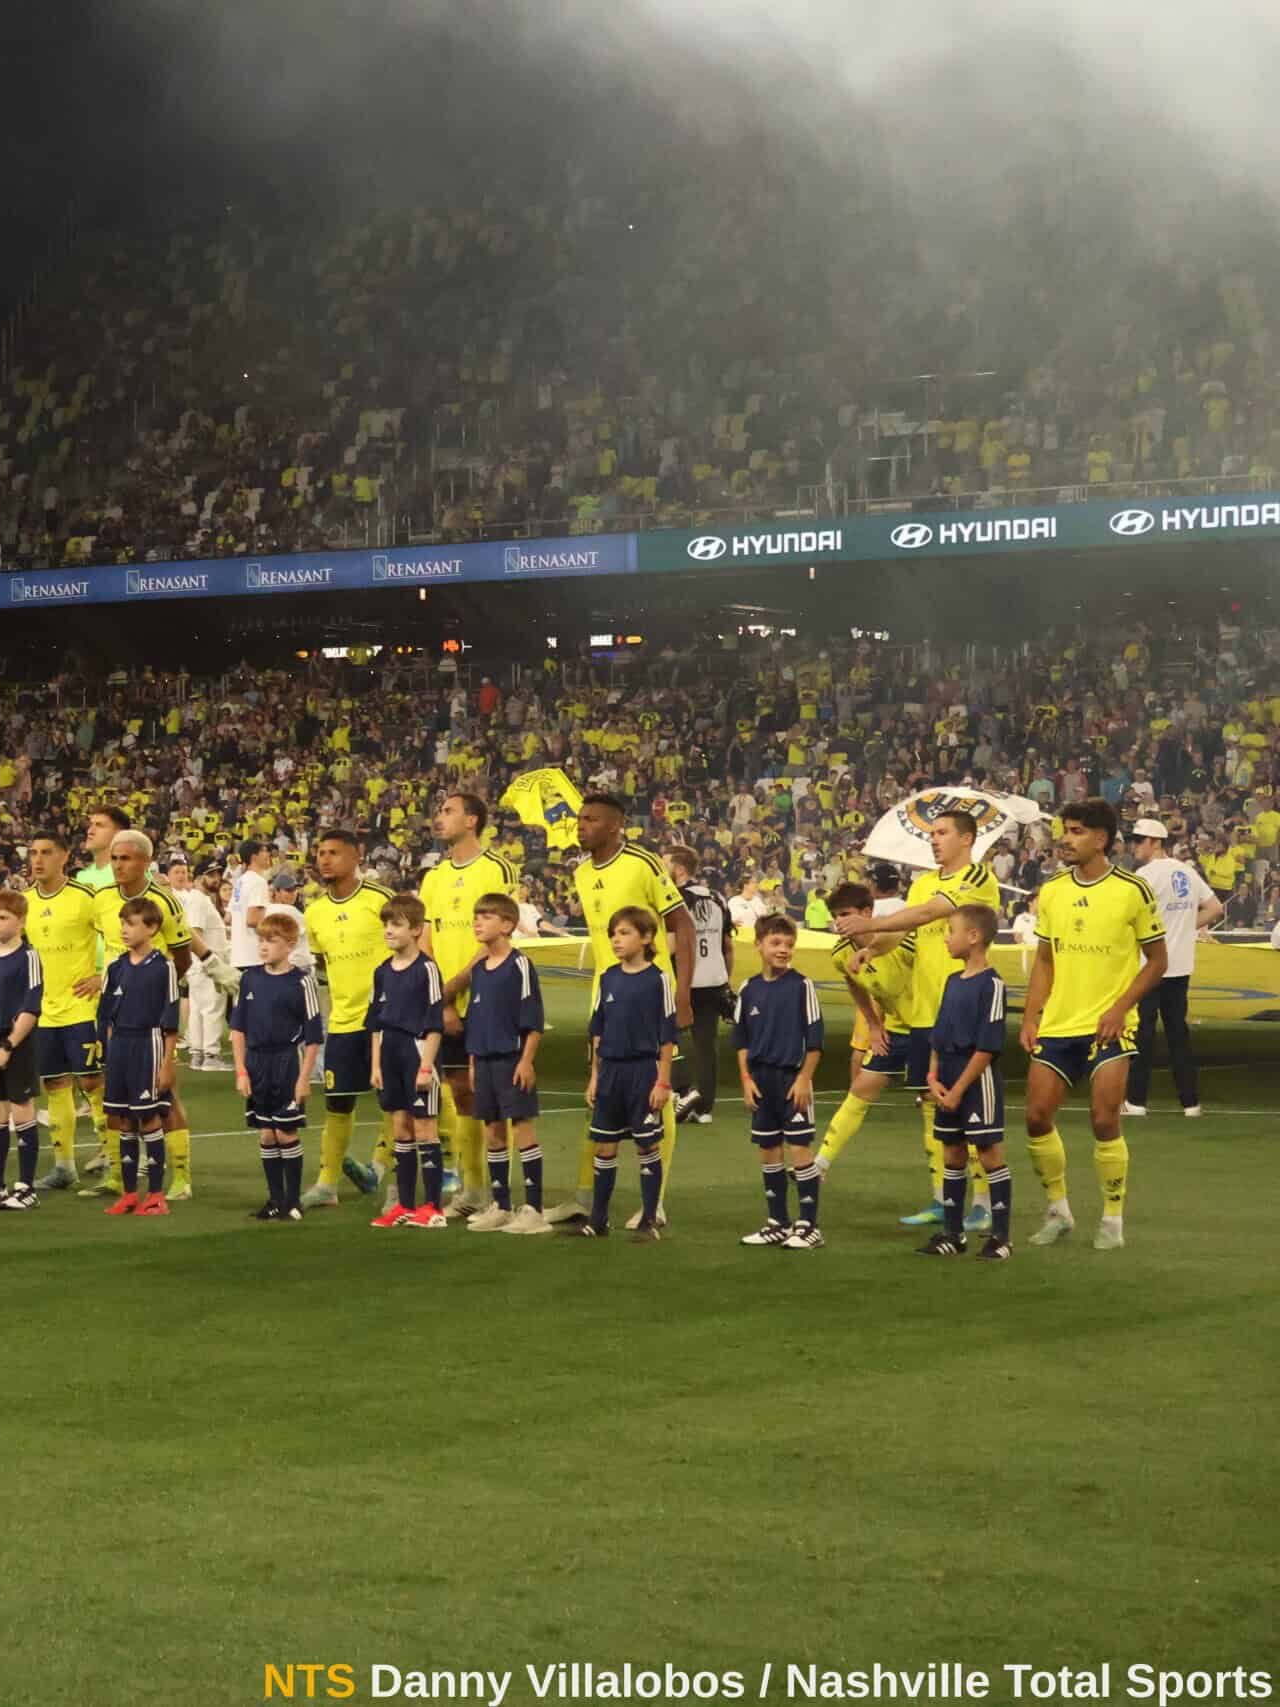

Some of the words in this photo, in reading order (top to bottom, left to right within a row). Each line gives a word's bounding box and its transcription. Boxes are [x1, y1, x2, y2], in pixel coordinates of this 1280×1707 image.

[939, 516, 1057, 545] HYUNDAI
[732, 529, 842, 557] HYUNDAI
[387, 559, 463, 578] RENASANT
[520, 551, 599, 570] RENASANT
[140, 574, 208, 592] RENASANT
[260, 567, 332, 586] RENASANT
[24, 581, 89, 599] RENASANT
[699, 938, 708, 958] 6
